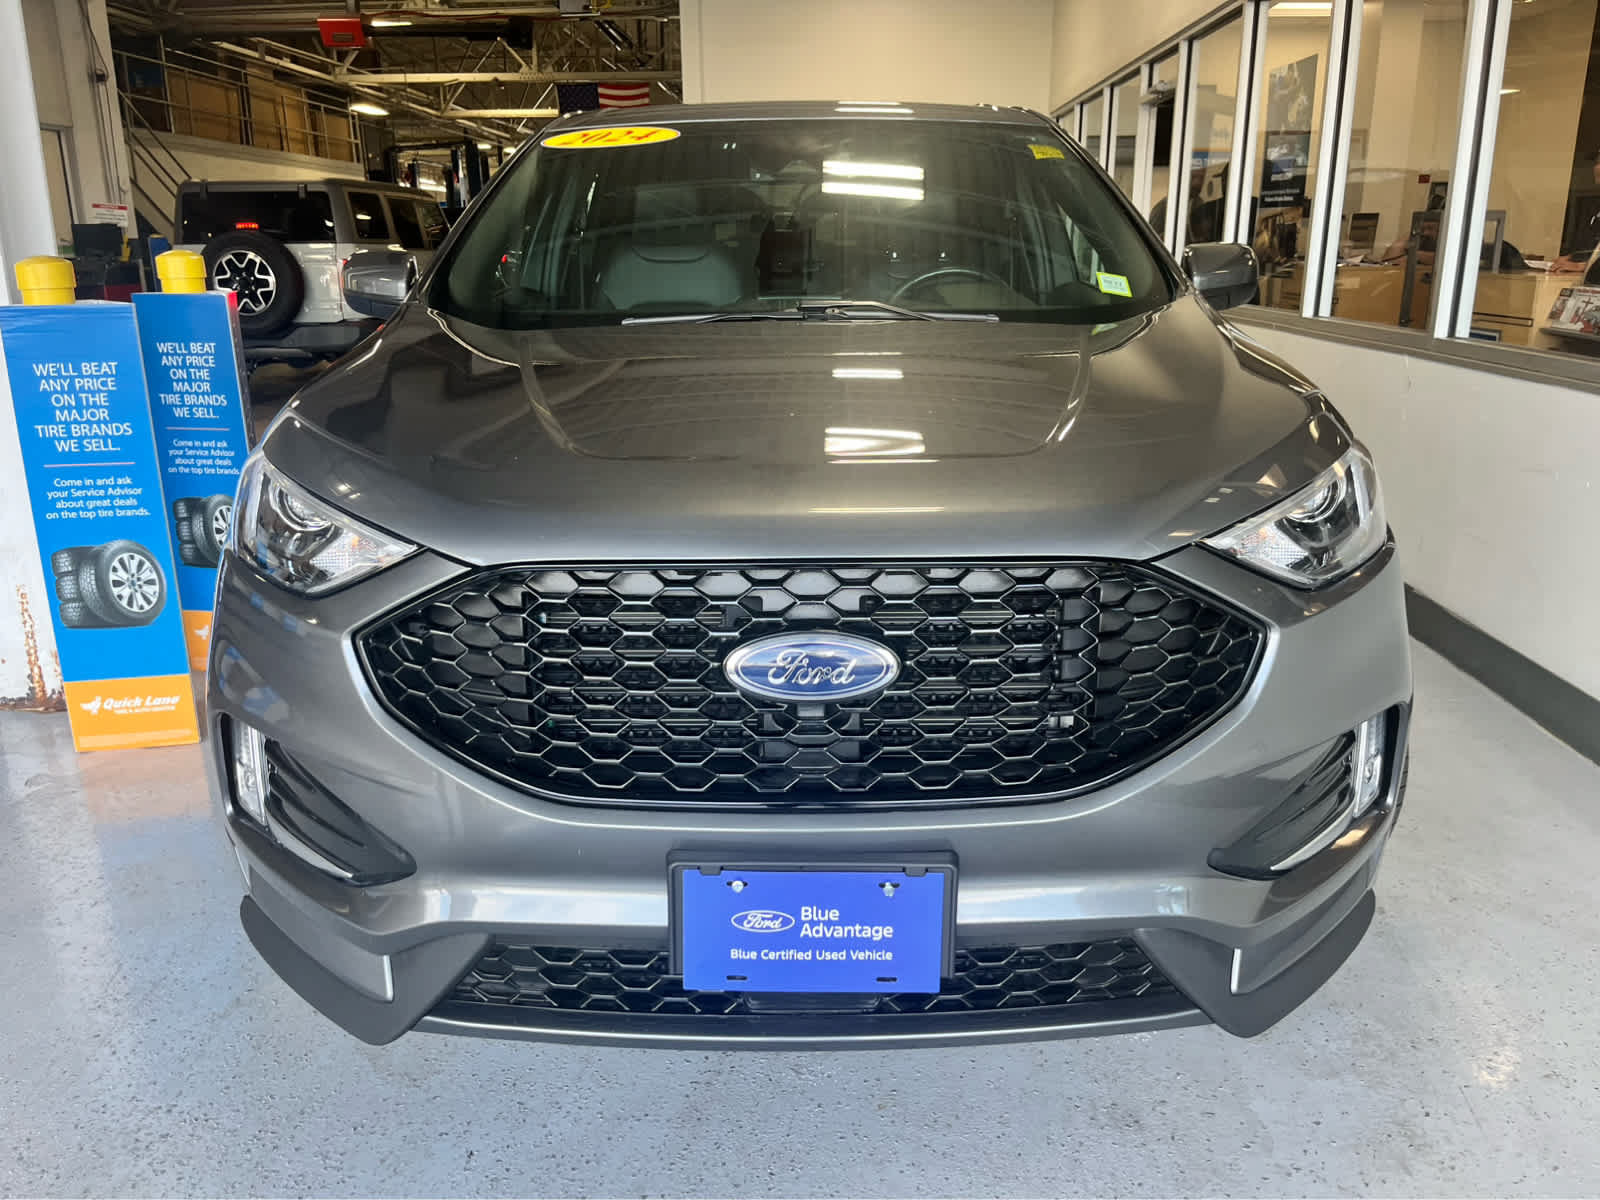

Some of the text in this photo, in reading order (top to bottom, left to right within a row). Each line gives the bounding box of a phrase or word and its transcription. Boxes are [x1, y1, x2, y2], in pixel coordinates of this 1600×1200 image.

[559, 130, 661, 145] 2024
[157, 342, 215, 354] WE'LL BEAT
[162, 356, 215, 367] ANY PRICE
[33, 362, 118, 377] WE'LL BEAT
[170, 369, 210, 380] ON THE
[40, 378, 116, 391] ANY PRICE
[173, 382, 210, 392] MAJOR
[51, 393, 109, 407] ON THE
[160, 394, 227, 406] TIRE BRANDS
[56, 408, 109, 422] MAJOR
[173, 408, 219, 418] WE SELL.
[34, 423, 132, 438] TIRE BRANDS
[56, 439, 120, 452] WE SELL.
[173, 439, 192, 447] Come
[196, 458, 213, 466] great
[54, 476, 132, 488] Come in and ask
[47, 487, 142, 499] your Service Advisor
[56, 497, 137, 508] about great deals
[46, 507, 151, 519] on the top tire brands.
[768, 649, 858, 685] Ford
[104, 697, 142, 710] Quick
[145, 696, 180, 705] Lane
[801, 907, 839, 920] Blue
[743, 913, 783, 928] Ford
[800, 924, 893, 940] Advantage
[730, 949, 893, 961] Blue Certified Used Vehicle
